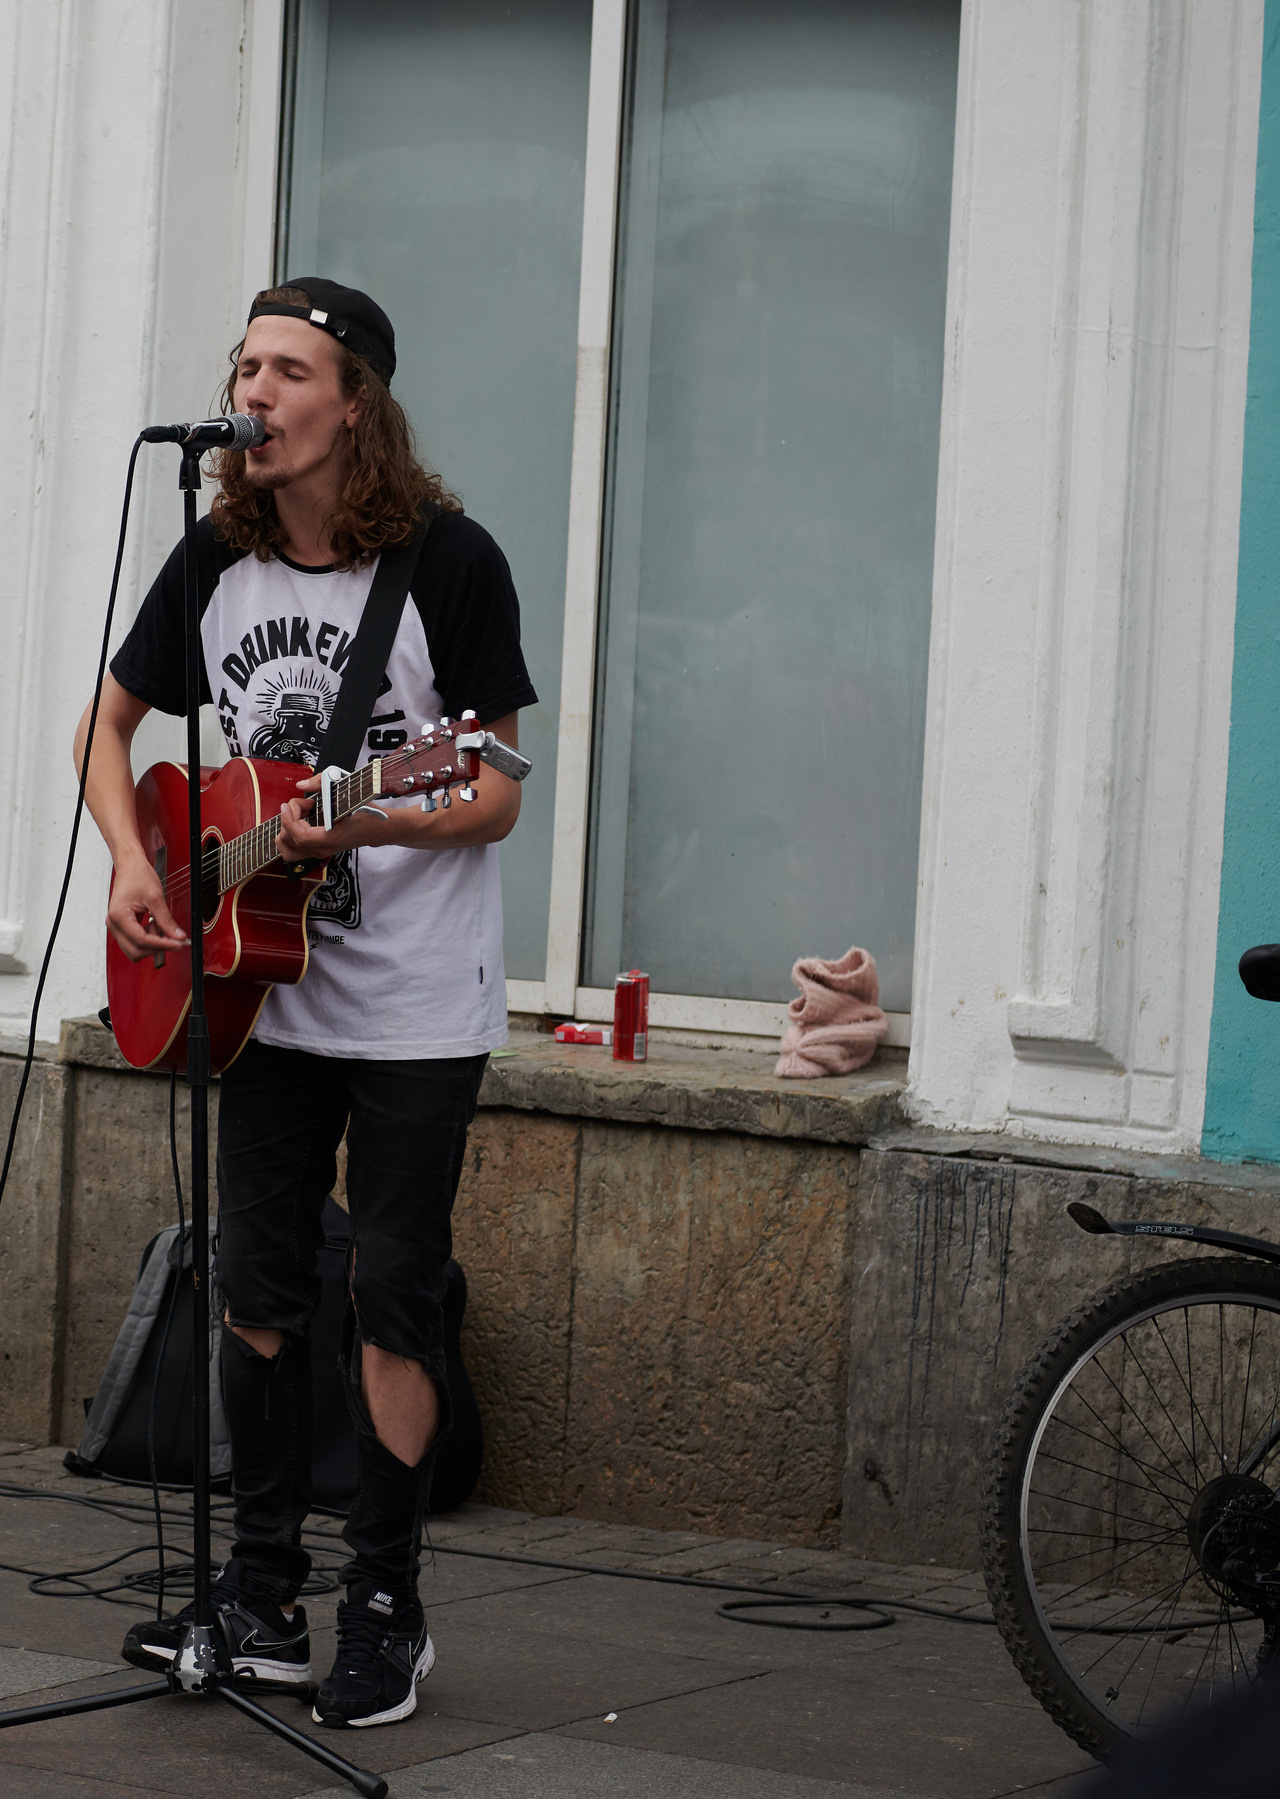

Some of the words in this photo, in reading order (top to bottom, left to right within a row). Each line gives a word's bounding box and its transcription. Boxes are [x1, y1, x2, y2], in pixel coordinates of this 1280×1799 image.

[218, 687, 243, 758] EST
[1135, 1225, 1194, 1236] STELS
[373, 1591, 394, 1606] NIKE
